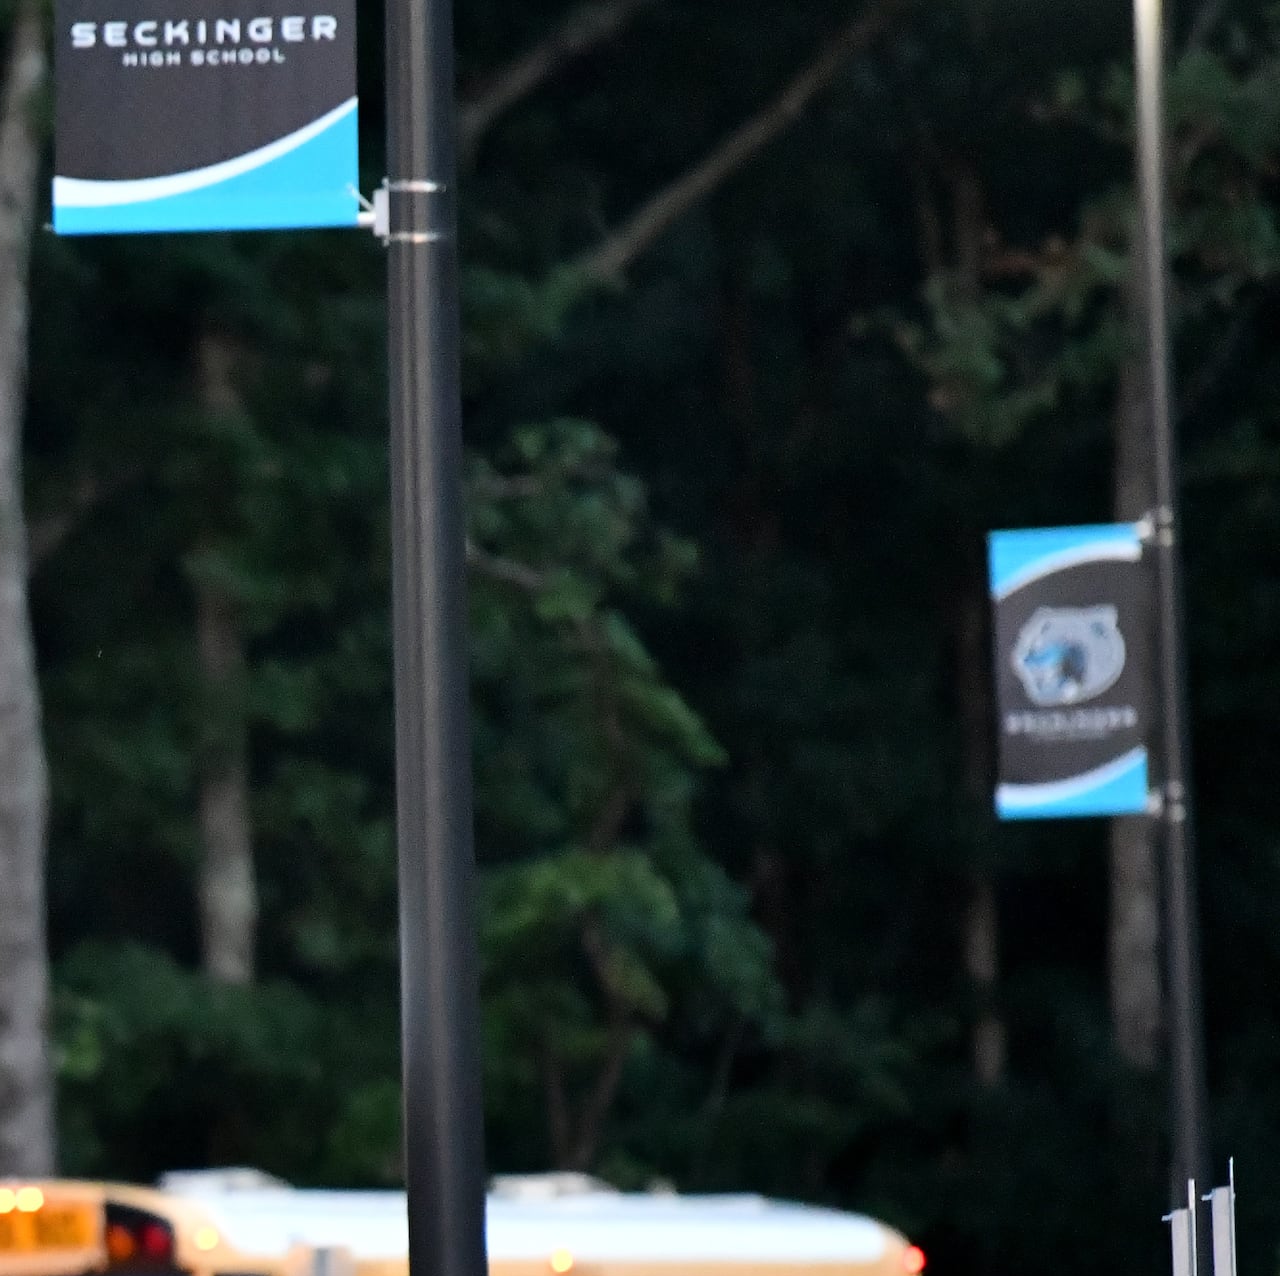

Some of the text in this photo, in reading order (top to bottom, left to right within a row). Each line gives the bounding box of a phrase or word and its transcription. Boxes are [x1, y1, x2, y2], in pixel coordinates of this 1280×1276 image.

[70, 14, 338, 49] SECKINGER
[122, 47, 286, 67] HIGH SCHOOL
